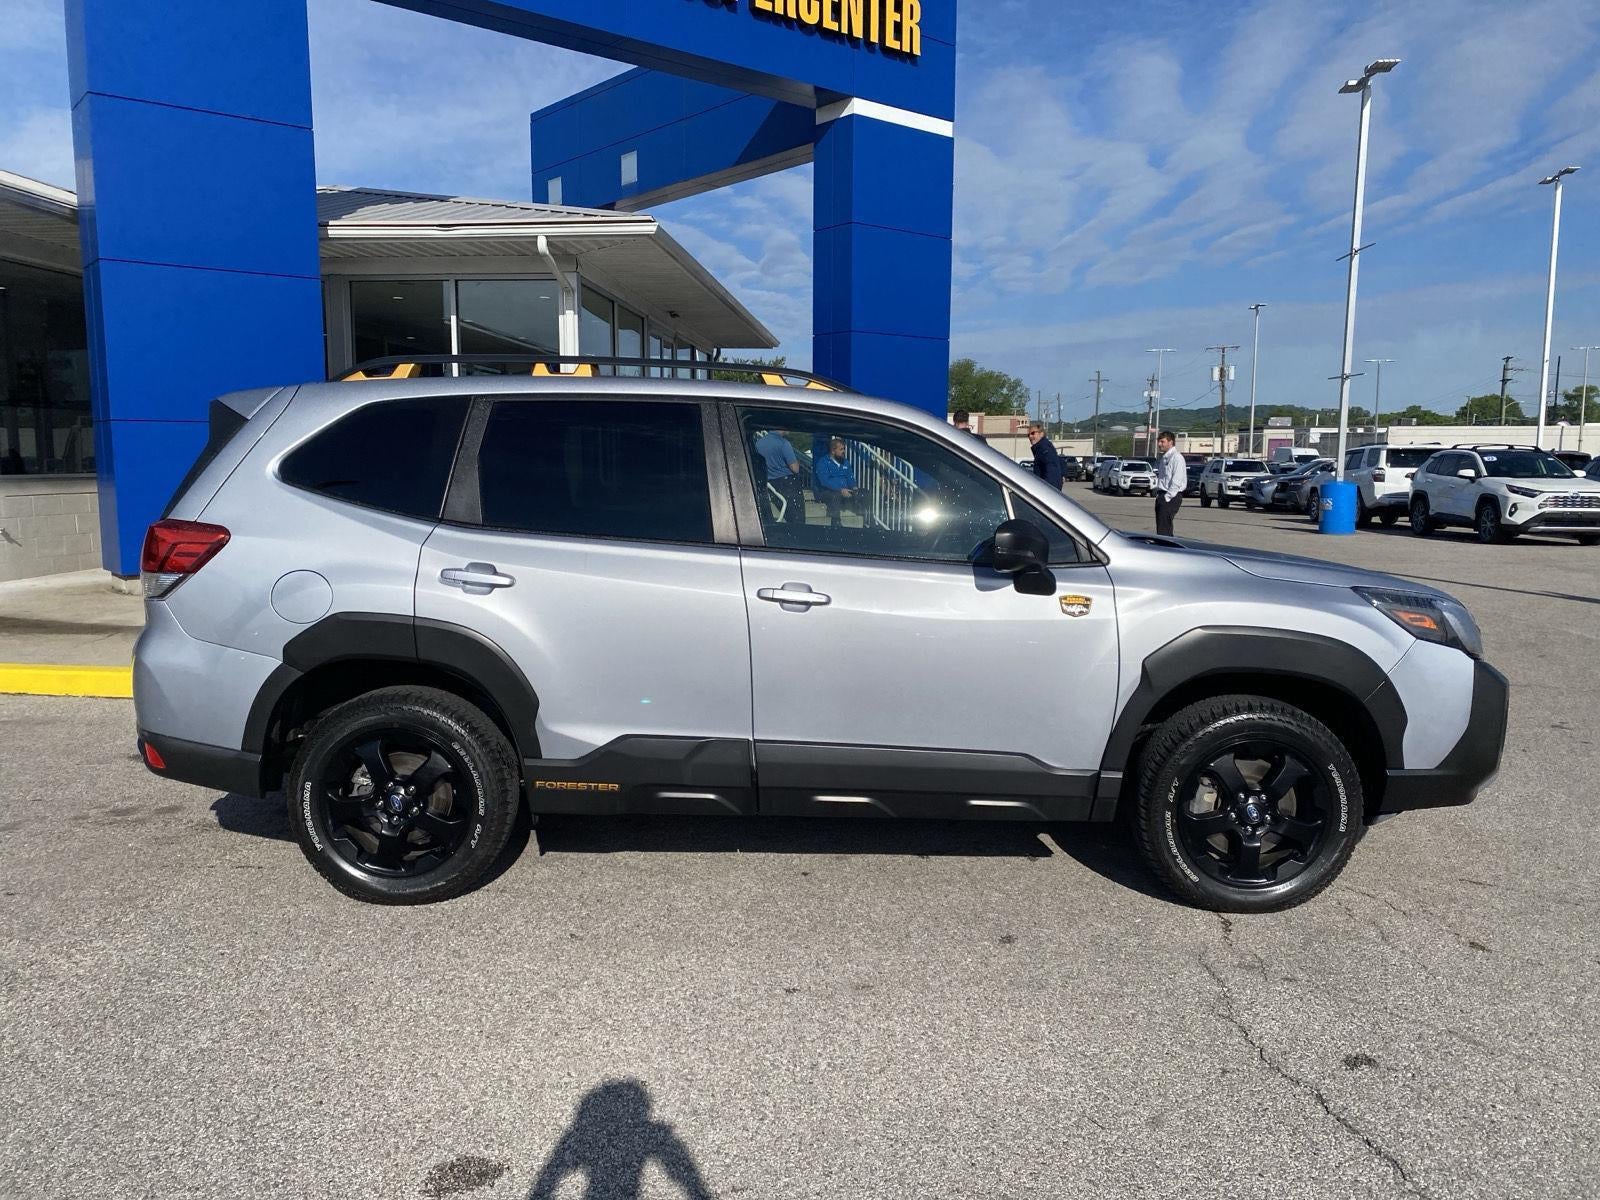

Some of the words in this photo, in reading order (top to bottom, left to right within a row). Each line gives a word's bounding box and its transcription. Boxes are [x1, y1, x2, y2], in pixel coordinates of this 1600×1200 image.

[755, 0, 921, 56] ENTER
[303, 782, 323, 851] YOKOHAMA
[535, 781, 619, 791] FORESTER
[1328, 764, 1348, 832] YOKOHAMA
